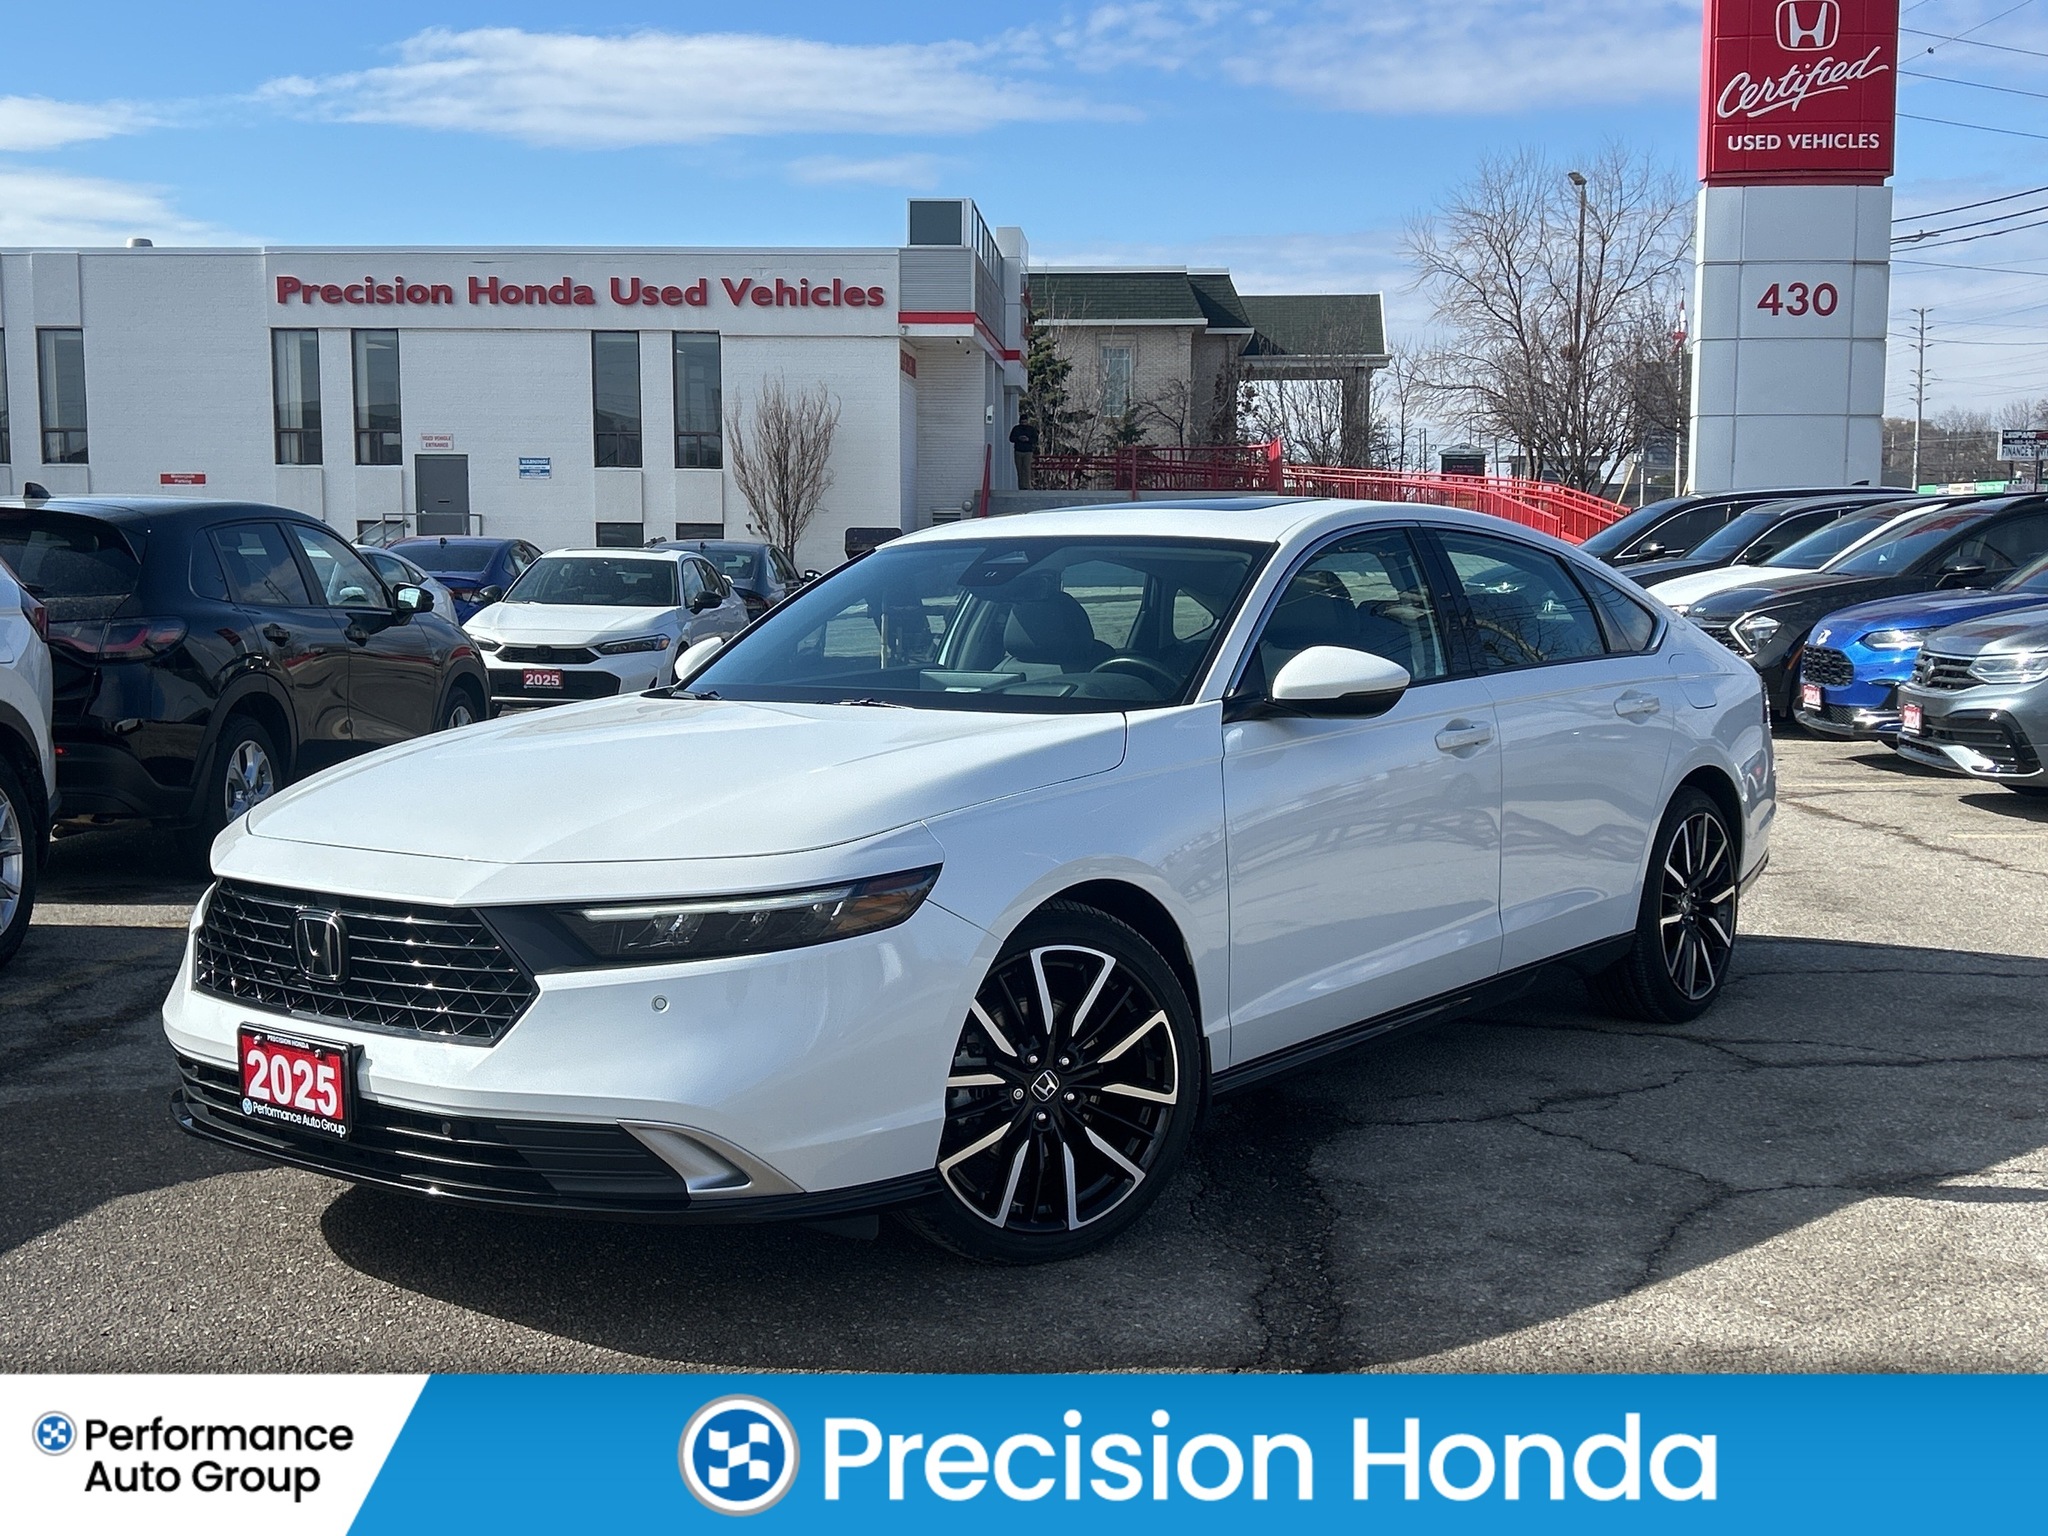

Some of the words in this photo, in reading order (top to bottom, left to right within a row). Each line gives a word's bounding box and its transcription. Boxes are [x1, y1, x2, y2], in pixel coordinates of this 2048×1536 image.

[1717, 45, 1889, 119] Certified
[1726, 133, 1782, 152] USED
[1786, 132, 1881, 151] VEHICLES
[275, 275, 454, 306] Precision
[467, 275, 597, 306] Honda
[608, 276, 709, 307] Used
[720, 276, 886, 307] Vehicles
[1756, 281, 1840, 317] 430
[525, 674, 560, 685] 2025
[246, 1049, 338, 1117] 2025
[252, 1101, 302, 1123] Performance
[302, 1113, 321, 1129] Auto
[321, 1118, 347, 1138] Group
